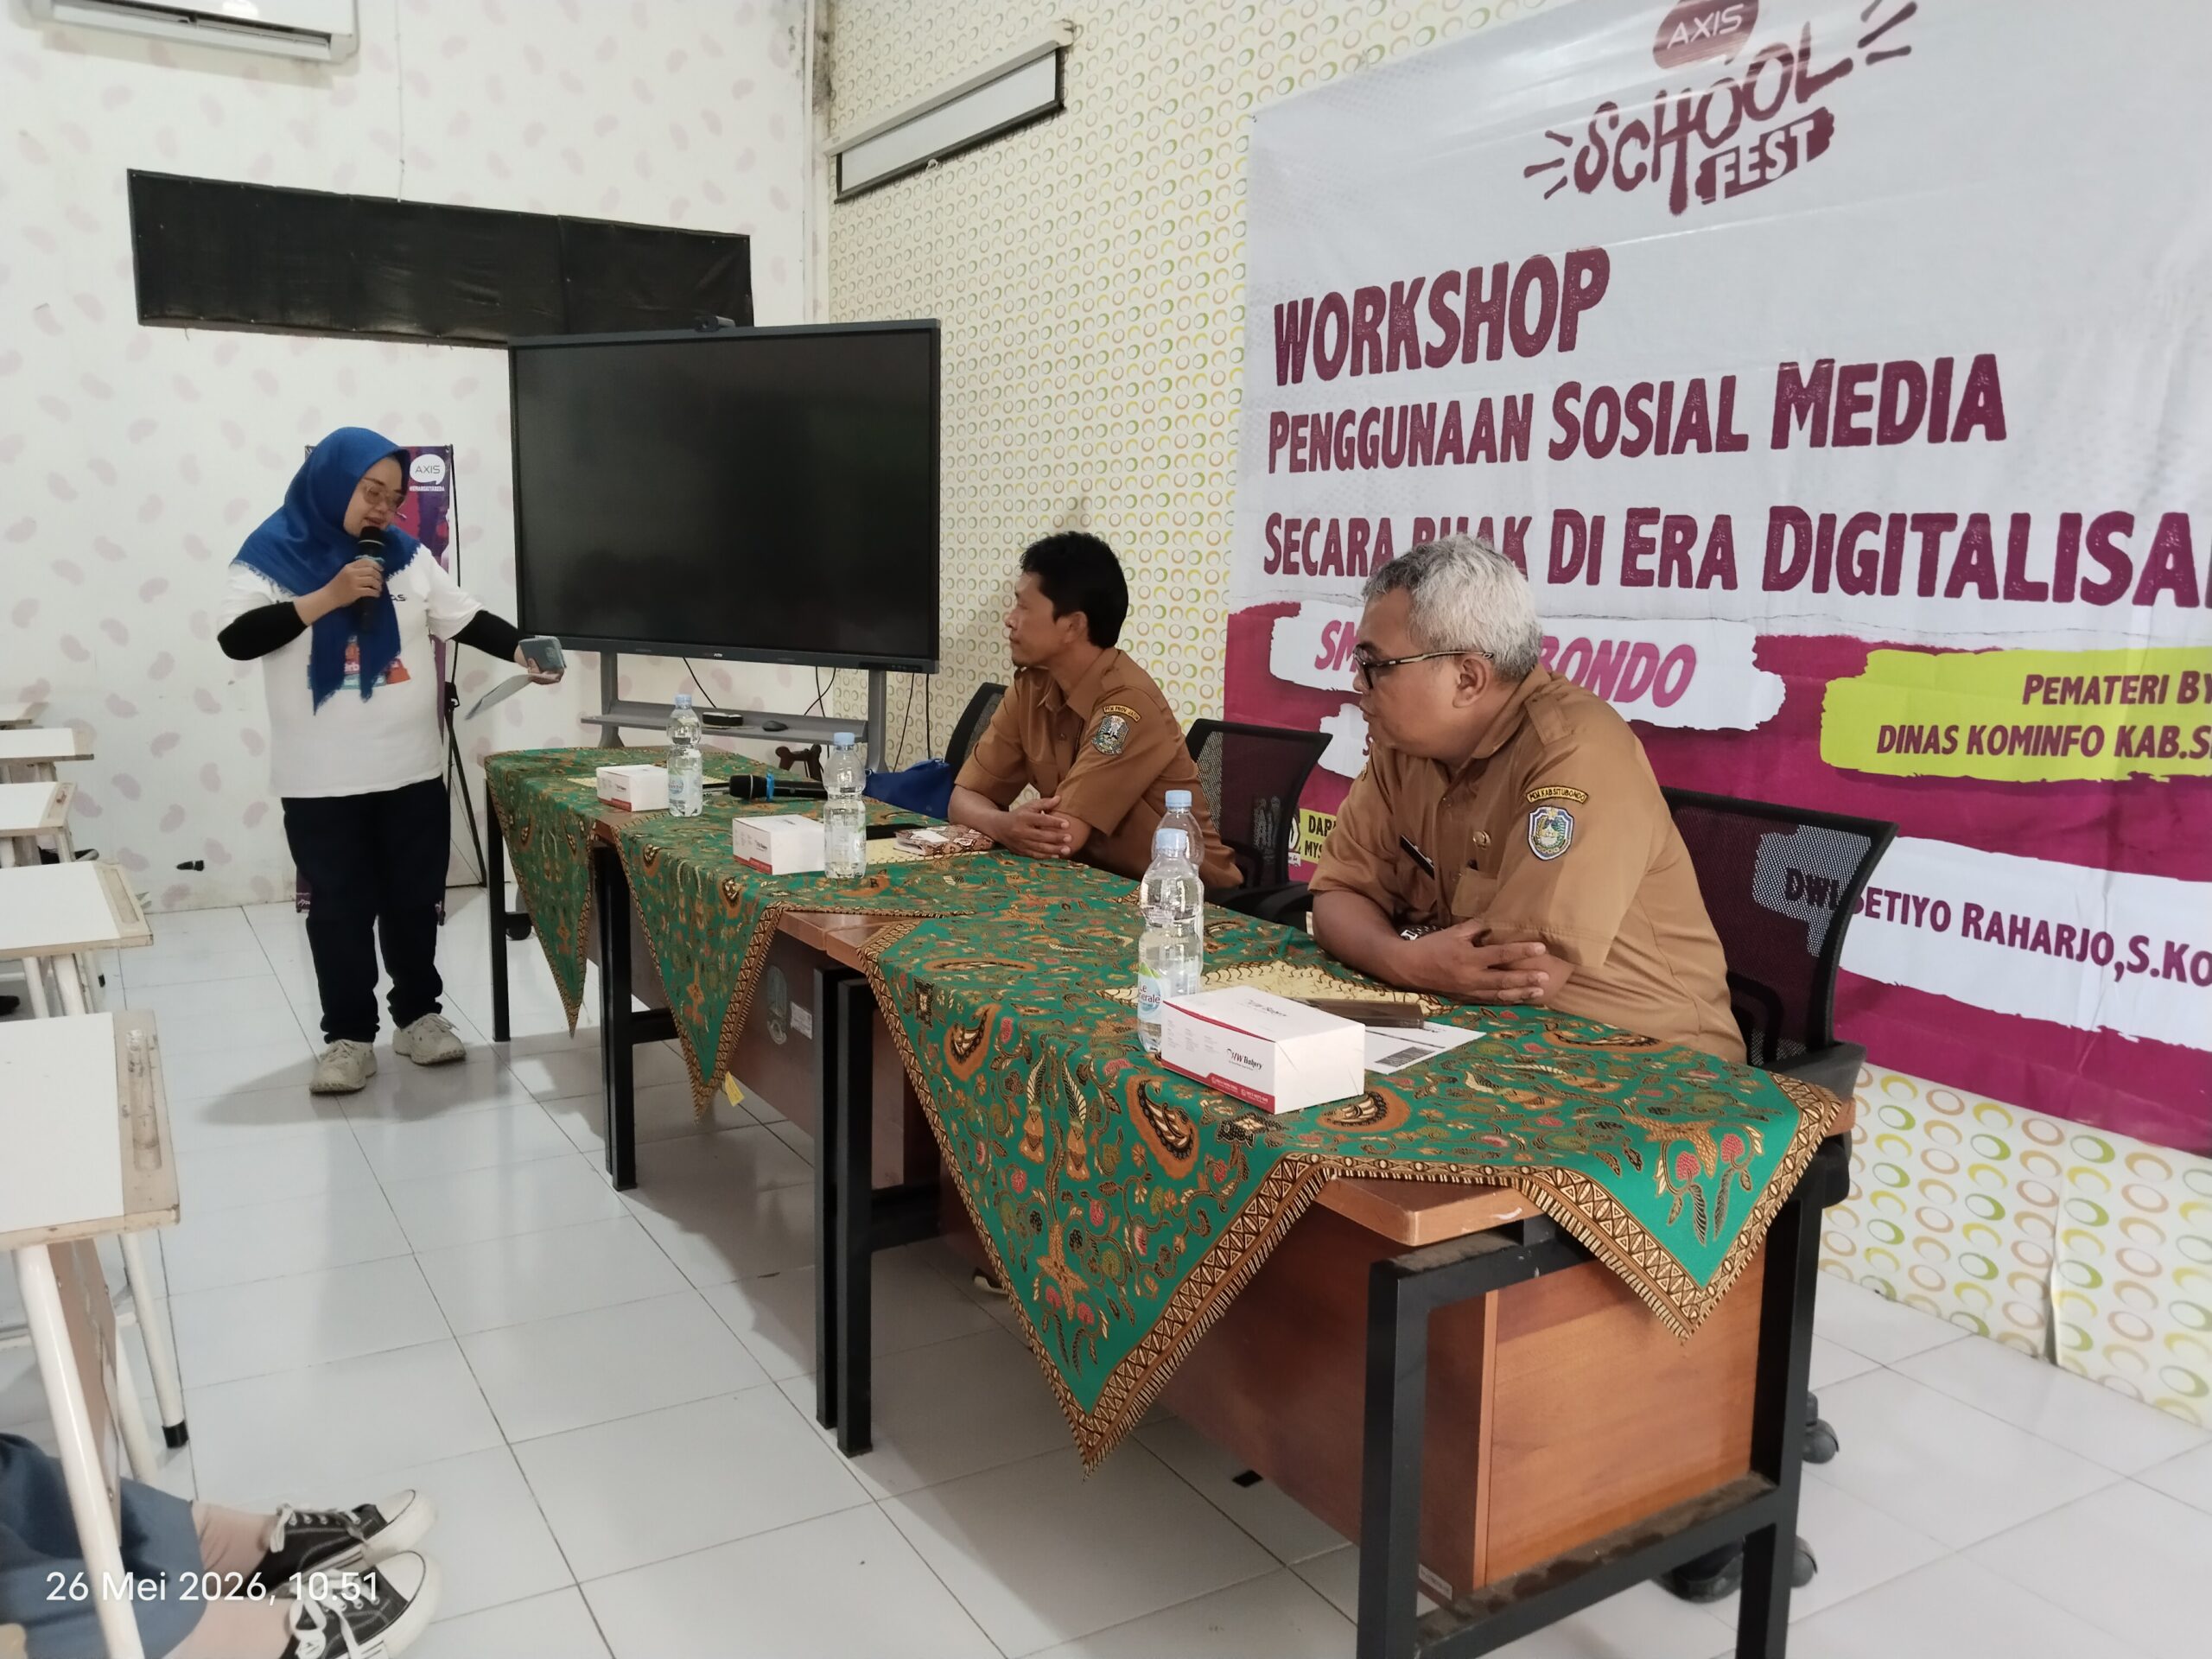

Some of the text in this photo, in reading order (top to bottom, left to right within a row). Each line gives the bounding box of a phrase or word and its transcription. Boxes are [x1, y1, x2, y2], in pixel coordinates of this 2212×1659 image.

[1666, 3, 1745, 50] AXIS
[1573, 21, 1853, 216] SCHOOL
[1715, 118, 1818, 201] FEST
[1274, 248, 1611, 386] WORKSHOP
[1269, 354, 2006, 474] PENGGUNAAN SOSIAL MEDIA
[415, 465, 441, 474] AXIS
[1264, 512, 1394, 576] SECARA
[1548, 509, 1605, 585] DI
[1620, 507, 1738, 590] ERA
[1762, 506, 2212, 608] DIGITALISA
[2023, 674, 2170, 705] PEMATERI
[1877, 725, 2212, 759] DINAS KOMINFO KAB.S
[1138, 993, 1160, 1004] erale
